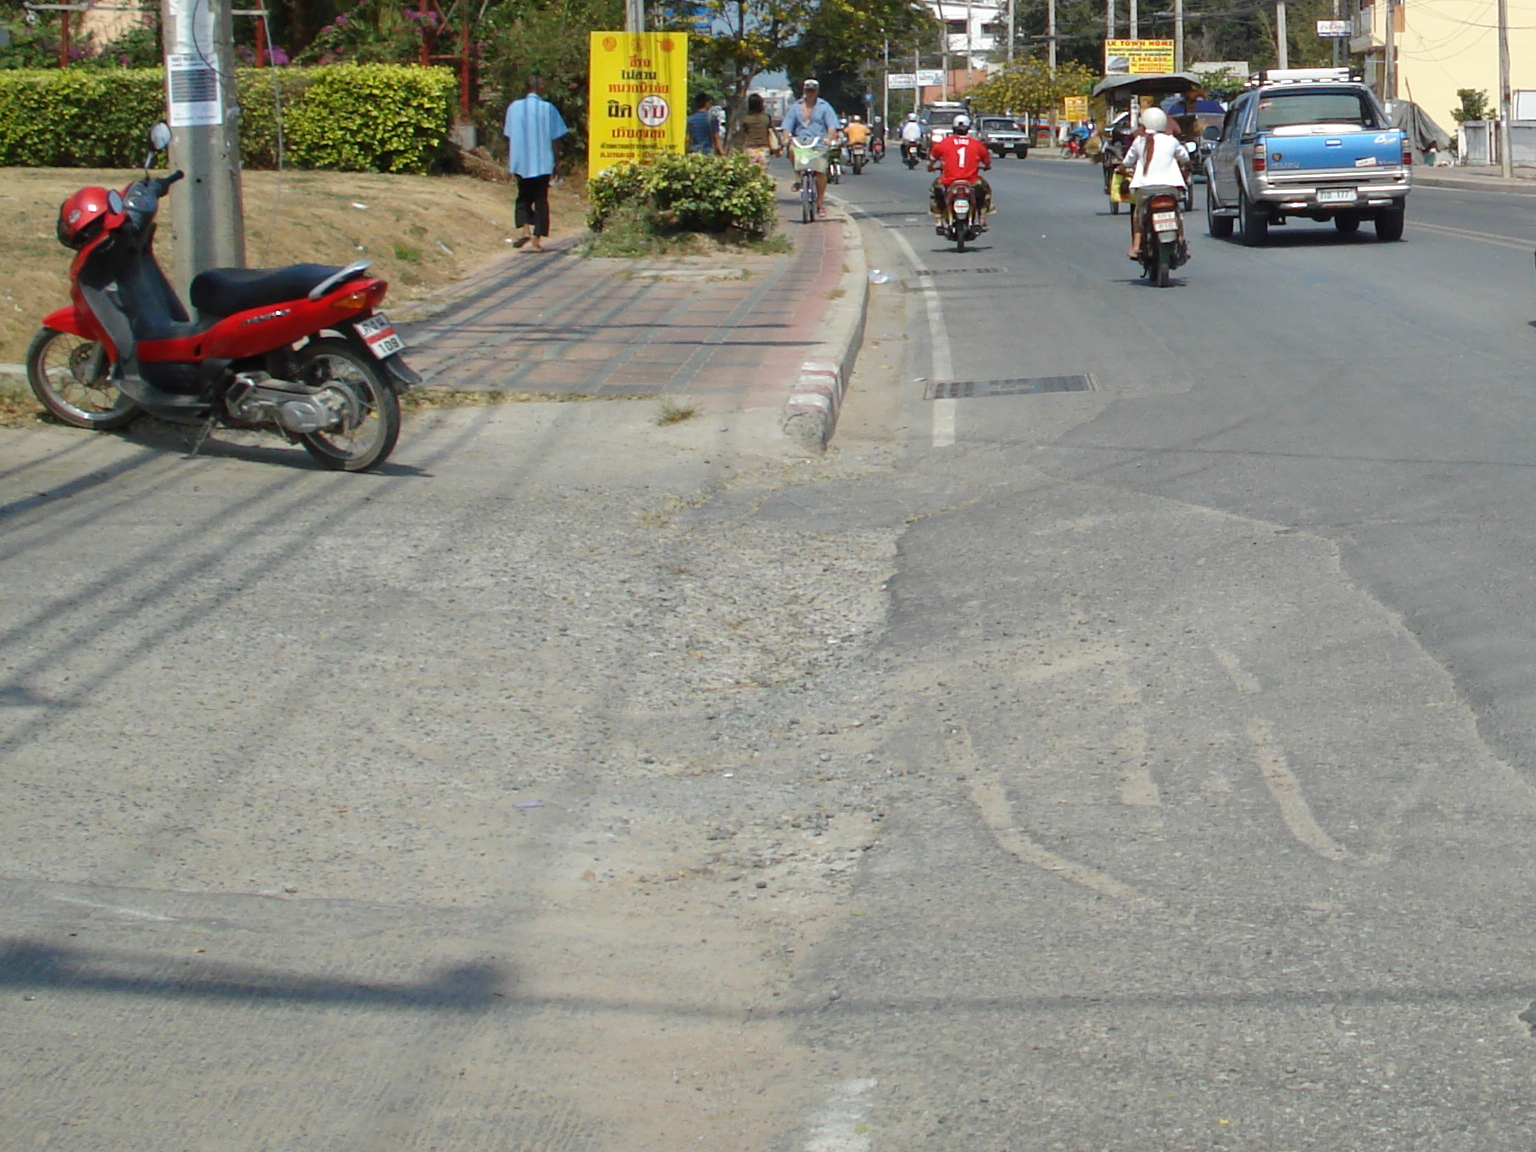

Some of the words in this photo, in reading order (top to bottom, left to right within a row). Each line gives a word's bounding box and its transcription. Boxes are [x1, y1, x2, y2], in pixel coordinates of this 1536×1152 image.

[641, 99, 666, 120] จับ
[957, 147, 967, 168] 1
[378, 337, 400, 353] 109
